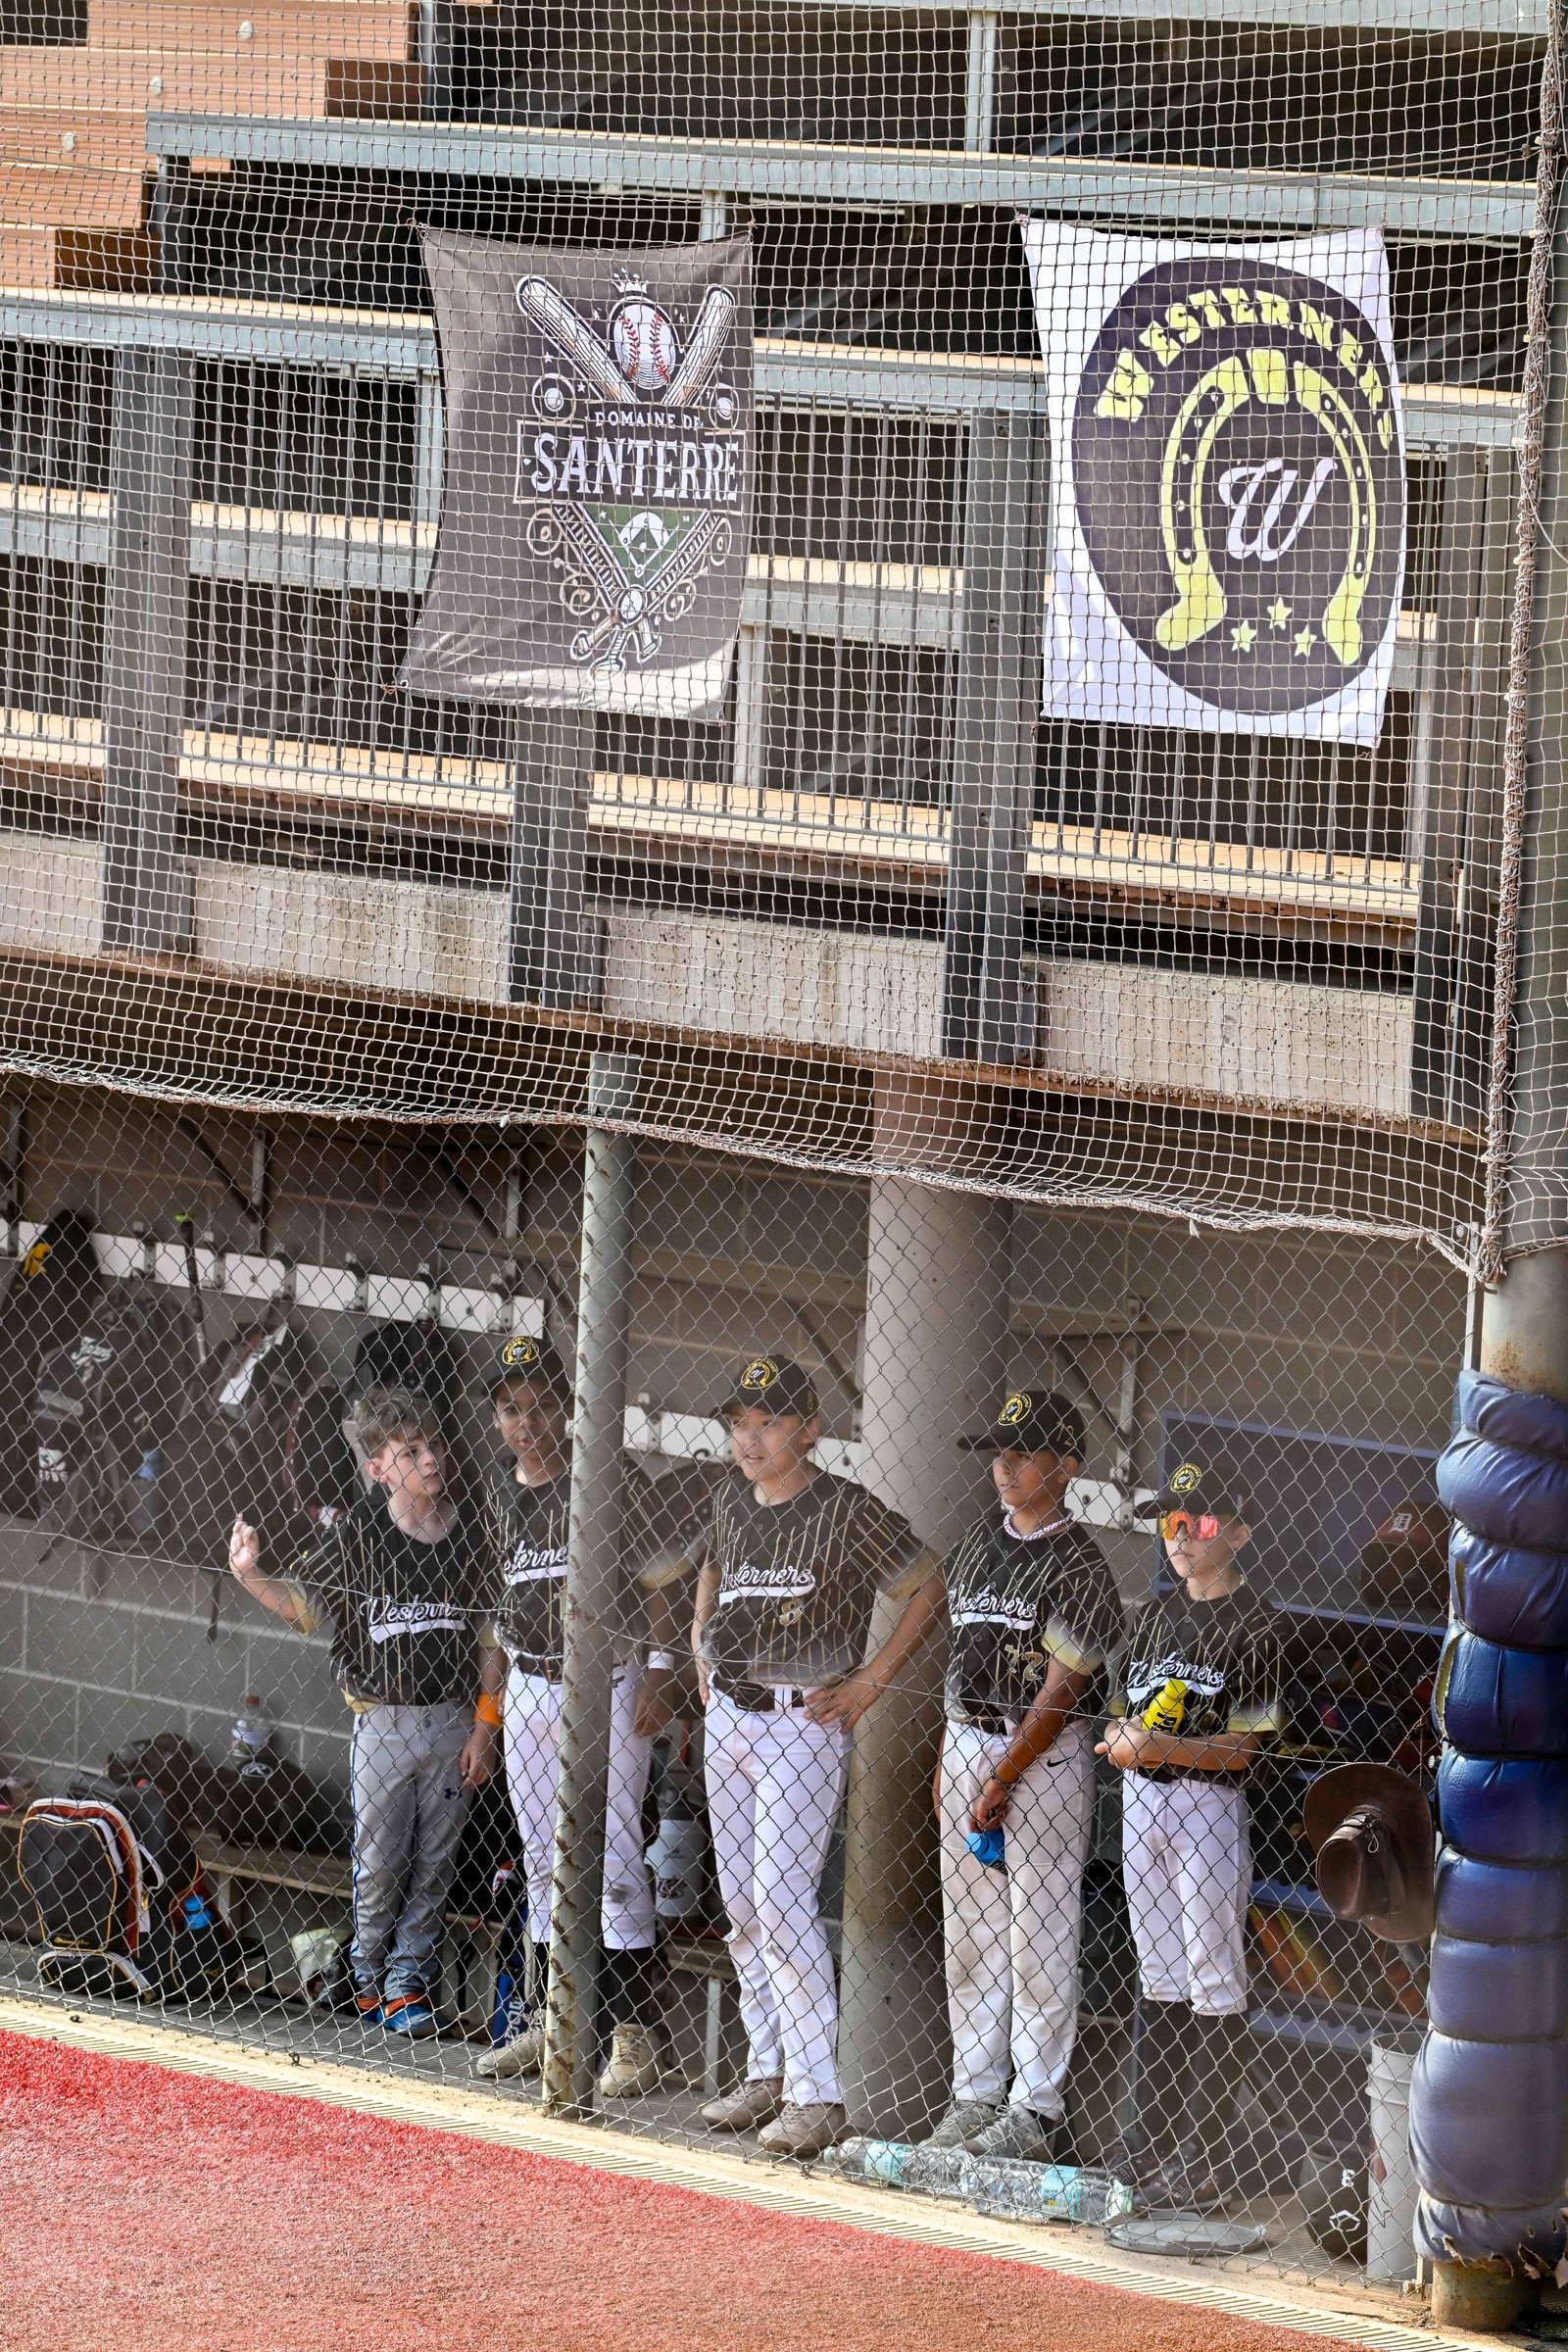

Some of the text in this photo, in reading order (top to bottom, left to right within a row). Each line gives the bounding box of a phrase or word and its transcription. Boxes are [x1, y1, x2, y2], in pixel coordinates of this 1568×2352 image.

[594, 411, 701, 431] DOMAINE DE
[530, 432, 740, 503] SANTERRE
[1218, 458, 1339, 563] W
[720, 1560, 816, 1591] terners
[948, 1584, 1038, 1619] Wsterers
[1126, 1650, 1224, 1689] Wsterners
